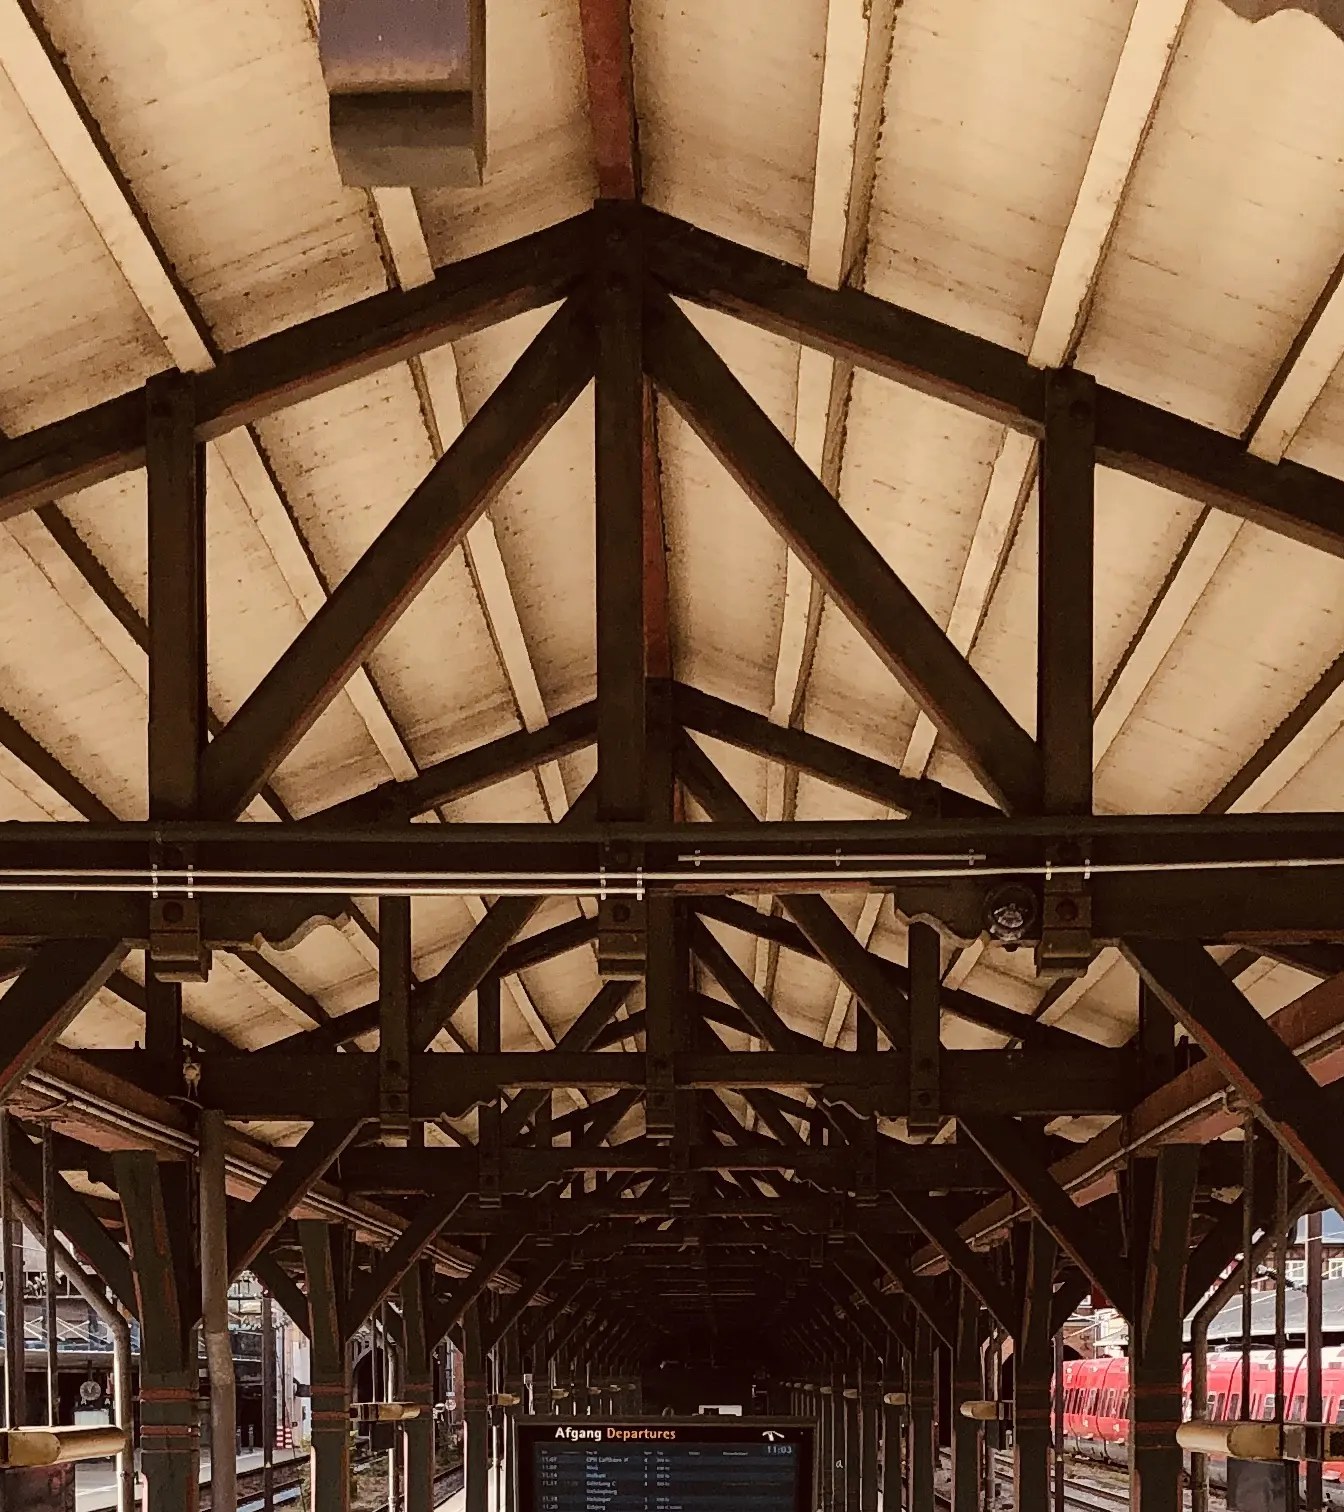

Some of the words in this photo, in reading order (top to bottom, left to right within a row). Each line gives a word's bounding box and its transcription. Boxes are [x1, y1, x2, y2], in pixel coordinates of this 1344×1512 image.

[555, 1427, 602, 1442] Afgang
[606, 1427, 676, 1441] Departures
[766, 1445, 792, 1455] 11:03
